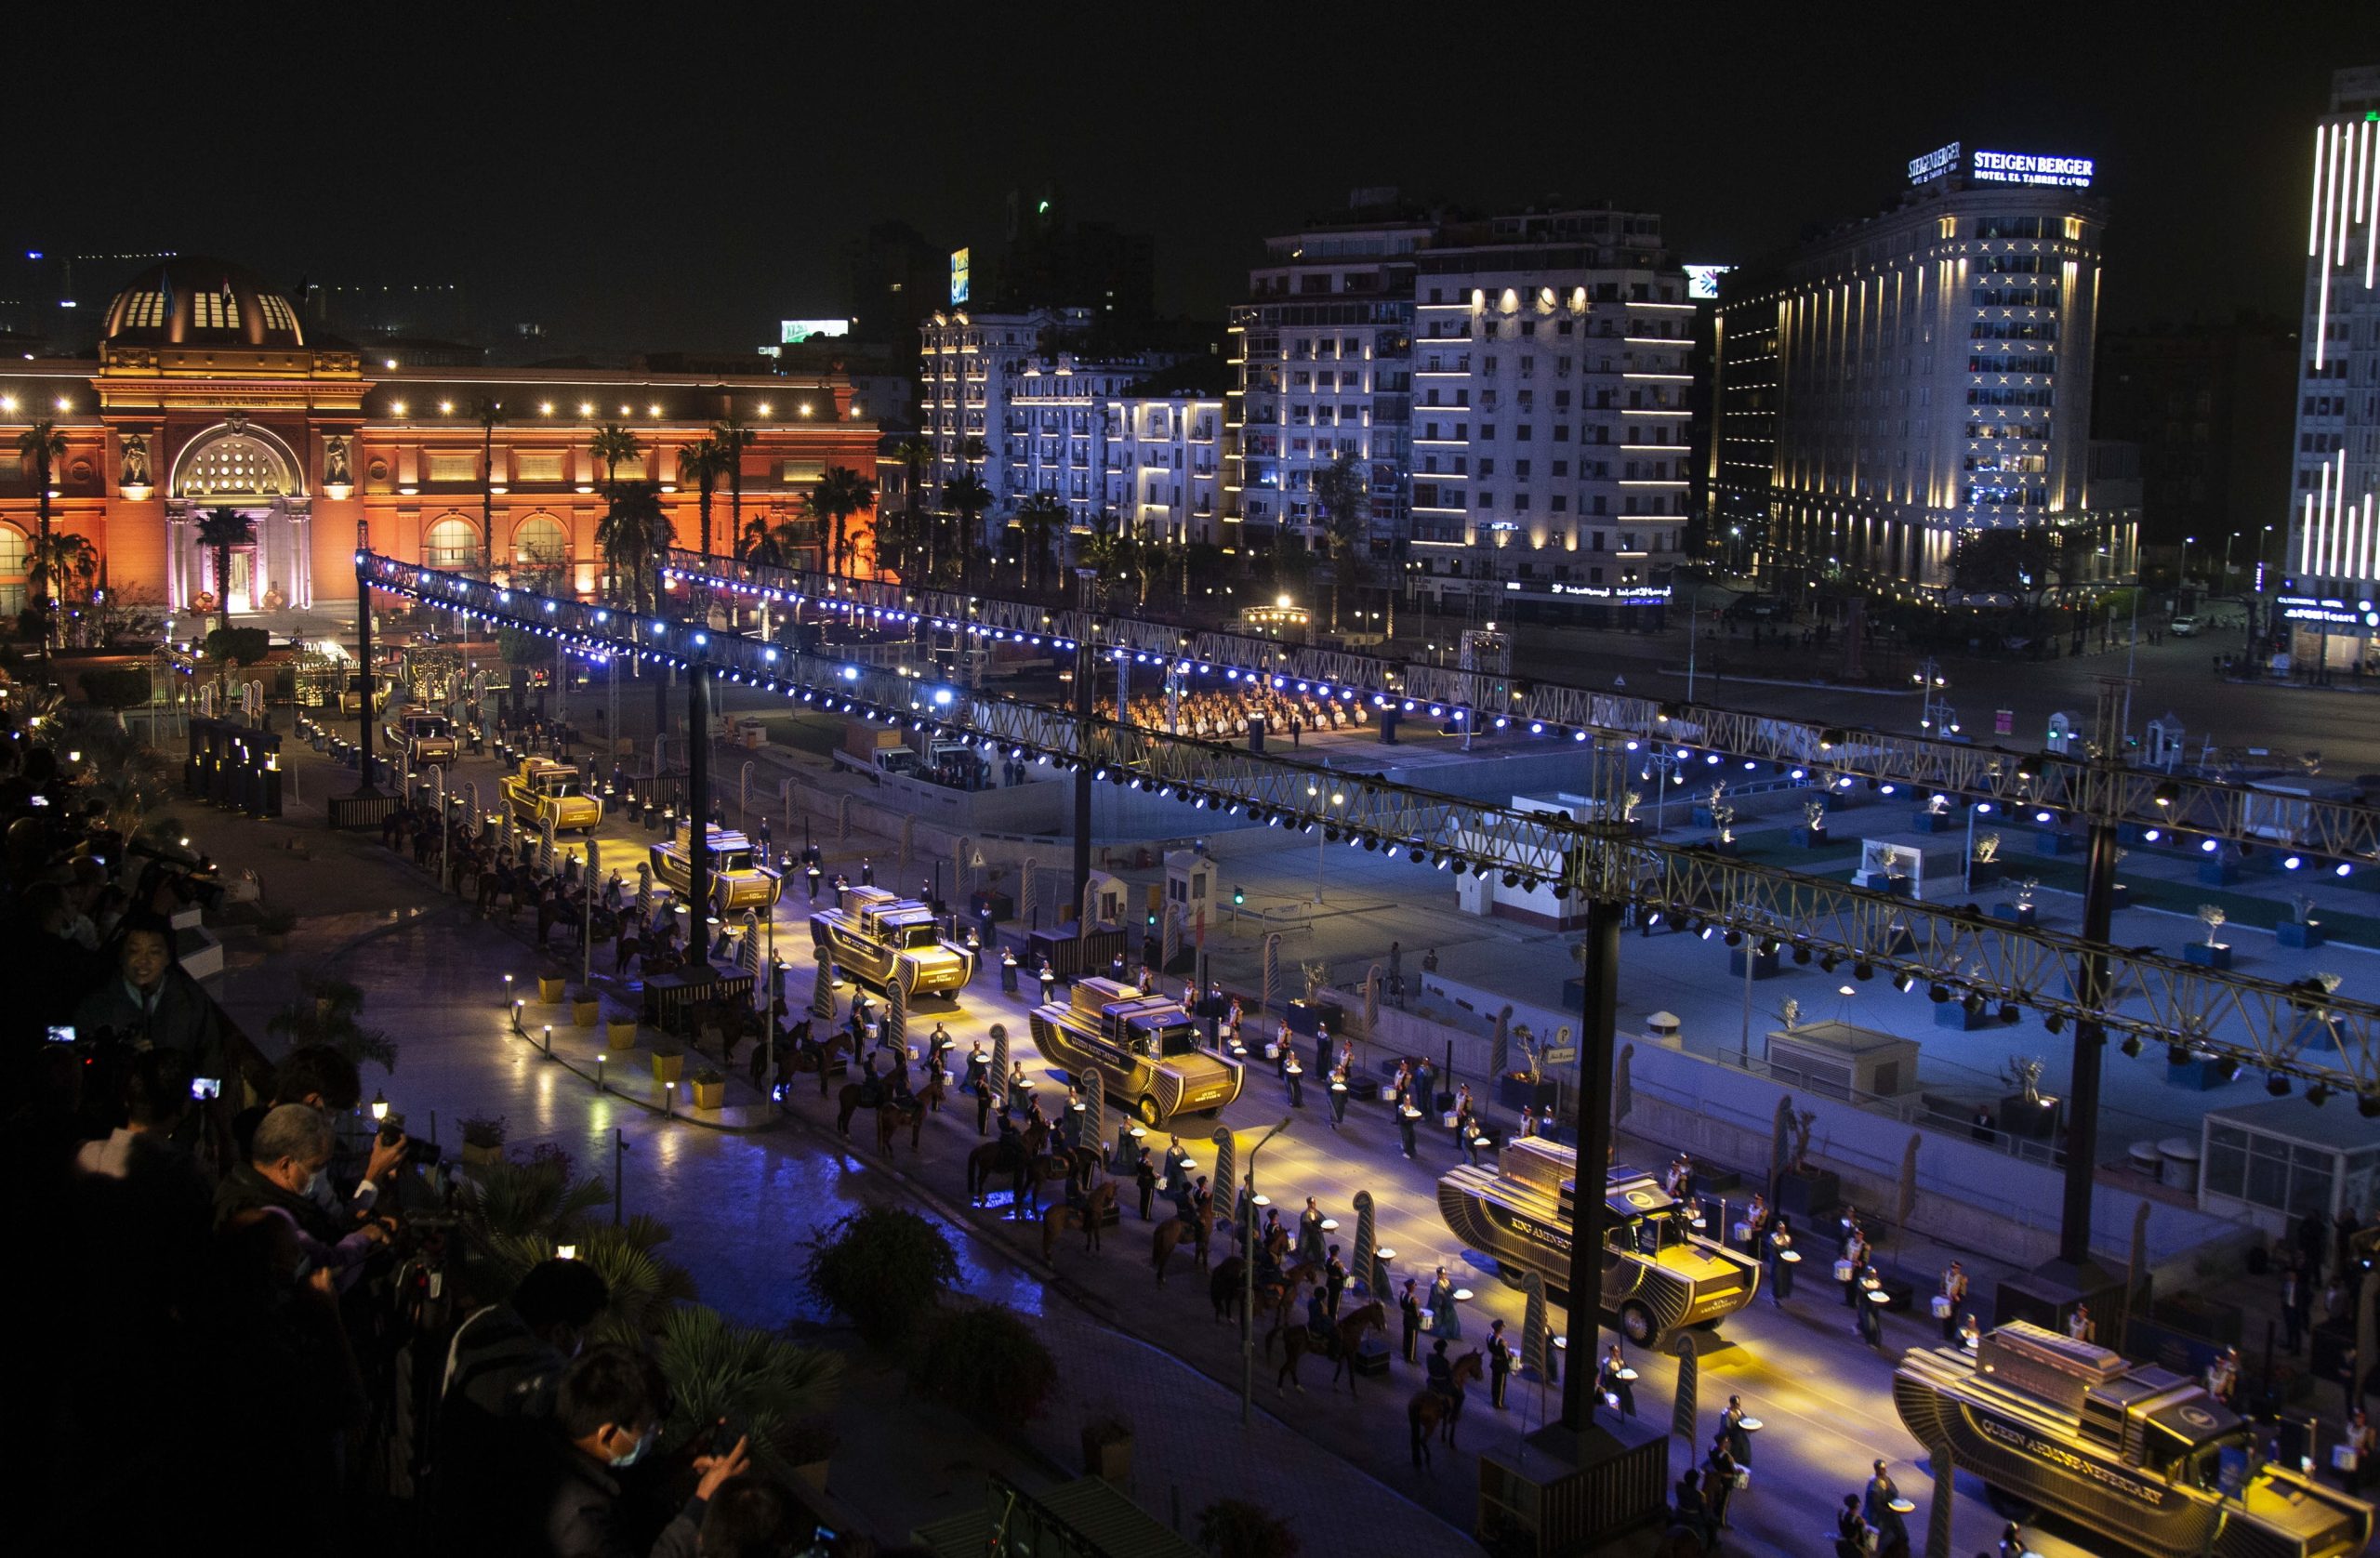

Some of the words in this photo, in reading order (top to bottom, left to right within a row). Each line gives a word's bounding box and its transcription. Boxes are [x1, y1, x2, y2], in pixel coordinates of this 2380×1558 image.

[1974, 152, 2094, 176] STEIGENBERGER
[1975, 170, 2006, 181] HOTEL
[2008, 173, 2021, 182] EL
[2022, 174, 2058, 185] TAHRIR
[1511, 1217, 1532, 1234] KING
[1532, 1227, 1573, 1251] AMENHOT
[1982, 1419, 2027, 1446] QUEEN
